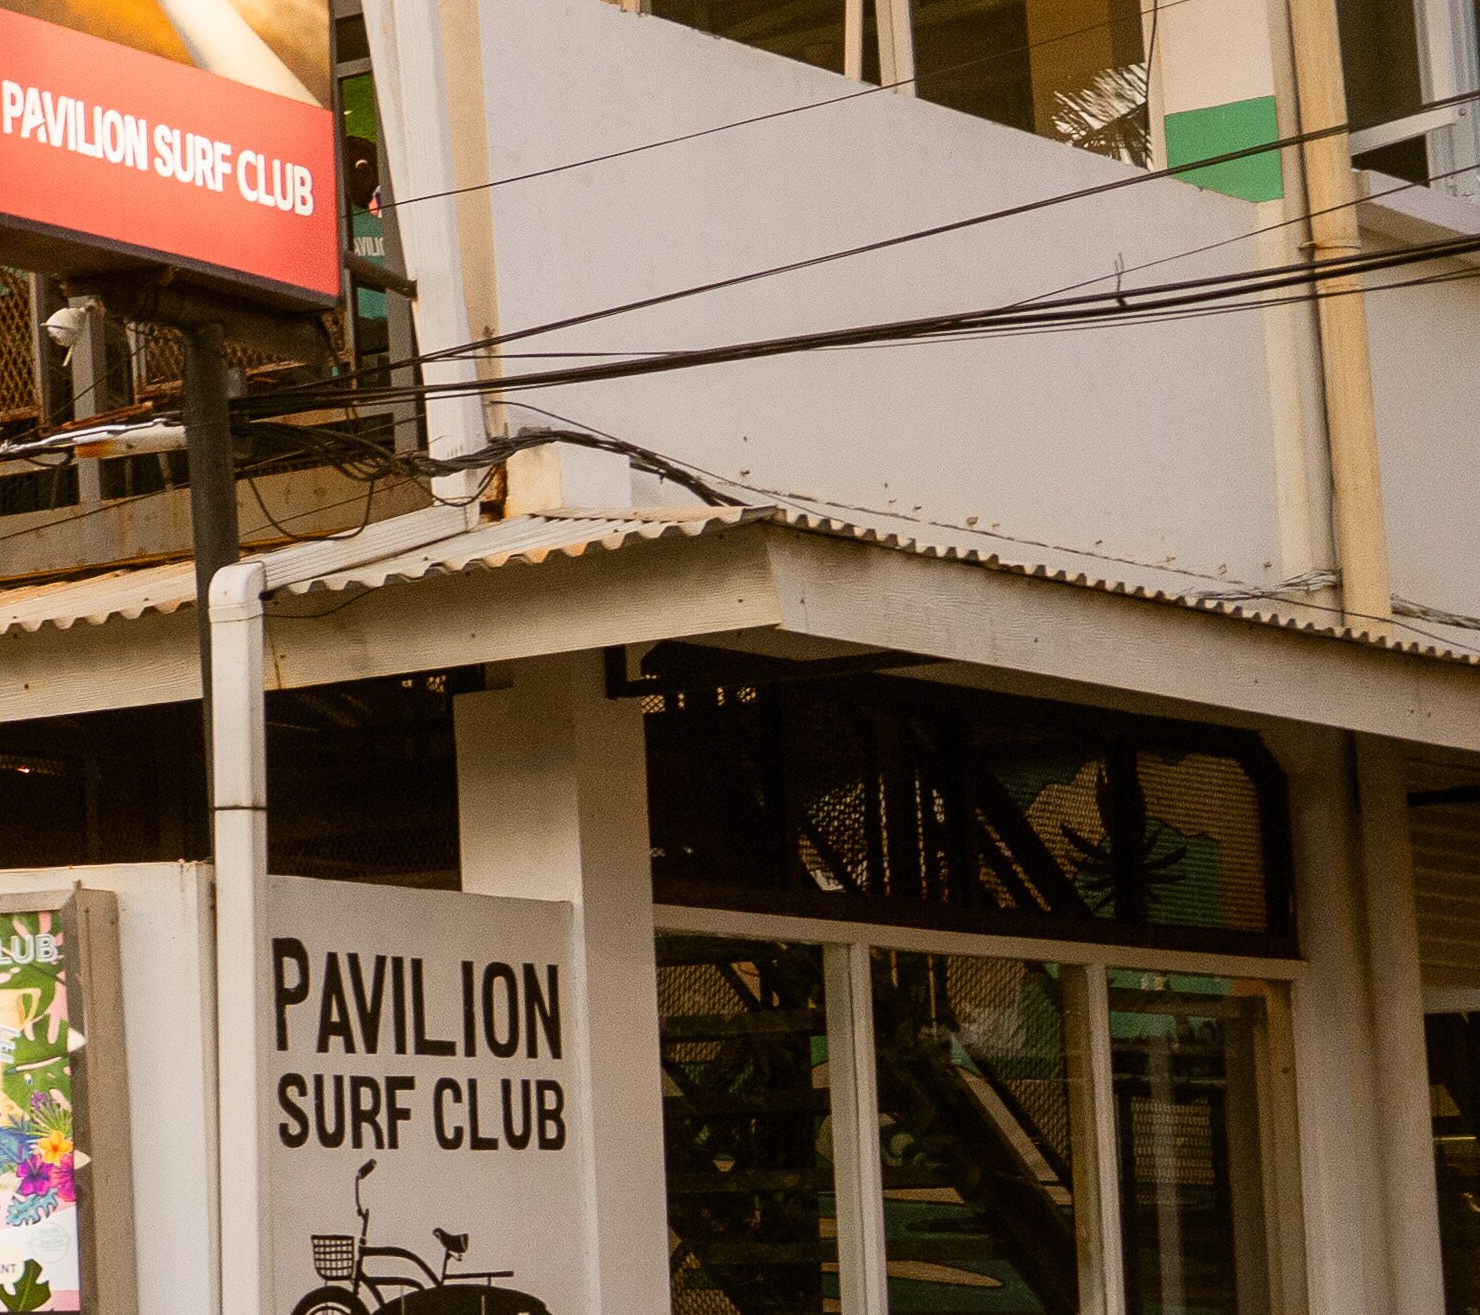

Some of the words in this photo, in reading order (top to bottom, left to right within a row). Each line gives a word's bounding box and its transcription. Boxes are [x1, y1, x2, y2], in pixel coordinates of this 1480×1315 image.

[1, 79, 149, 172] PAVILION
[153, 122, 233, 193] SURF
[236, 148, 315, 217] CLUB
[271, 936, 564, 1061] PAVILION
[278, 1072, 417, 1152] SURF
[431, 1075, 568, 1152] CLUB
